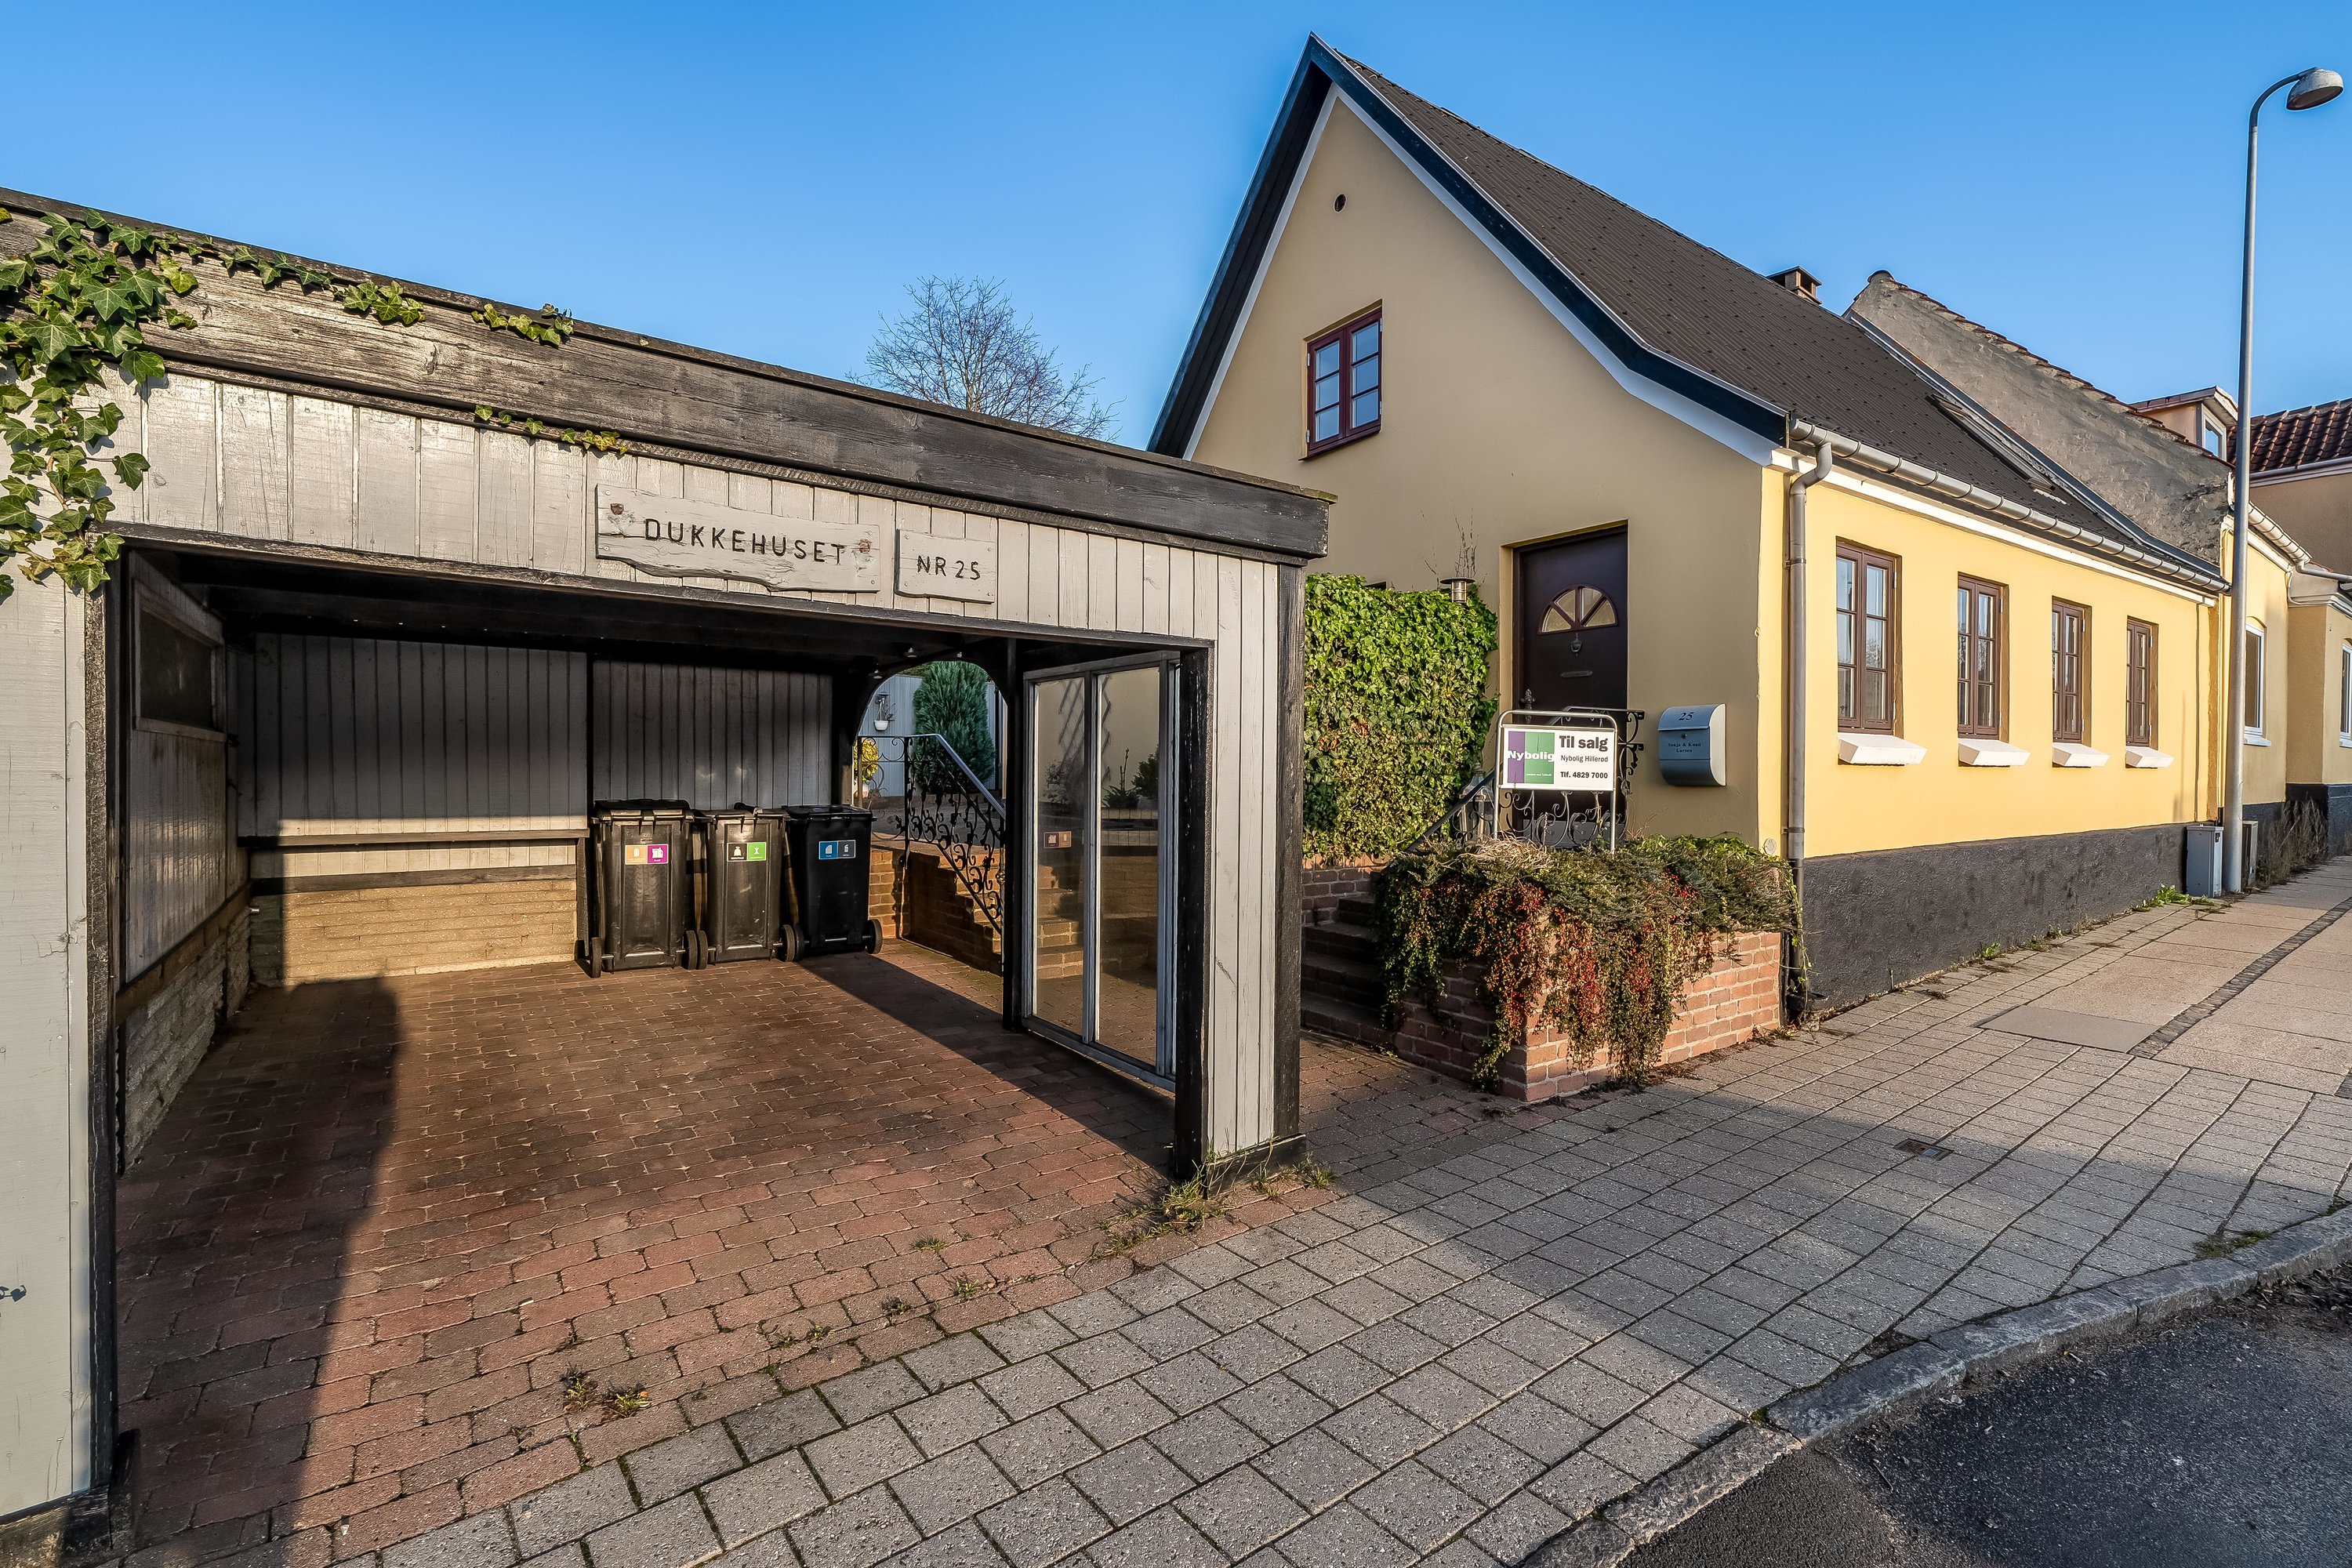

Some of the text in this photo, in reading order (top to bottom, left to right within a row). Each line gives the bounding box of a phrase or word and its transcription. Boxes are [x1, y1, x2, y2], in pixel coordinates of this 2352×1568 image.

[644, 517, 846, 566] DUKKEHUSET
[916, 555, 981, 580] NR 25
[1678, 711, 1694, 720] 25
[1559, 735, 1608, 752] Til salg
[1508, 750, 1555, 763] Nybolig
[1560, 754, 1584, 763] Nybolig
